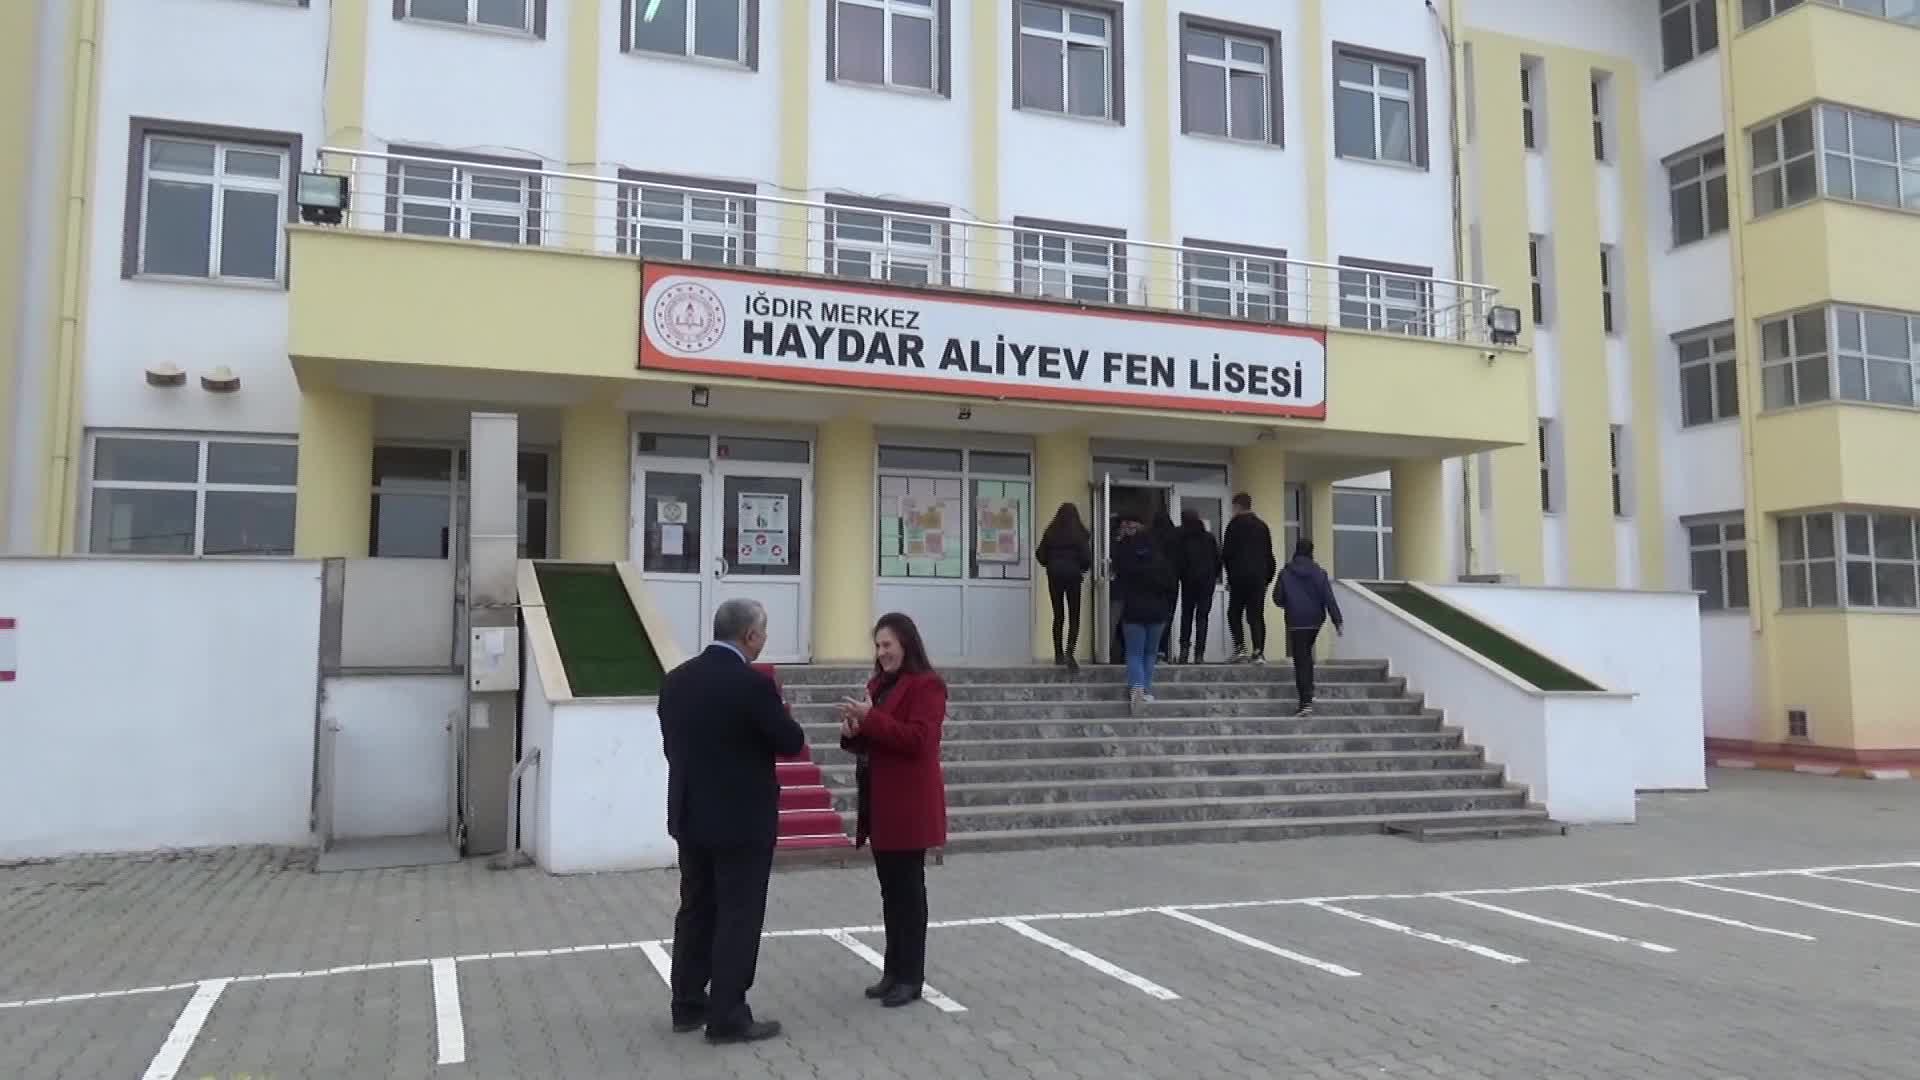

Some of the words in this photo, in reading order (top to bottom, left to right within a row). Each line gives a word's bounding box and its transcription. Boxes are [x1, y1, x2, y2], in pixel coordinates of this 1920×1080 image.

[745, 291, 812, 320] IĞDIR
[821, 302, 921, 330] MERKEZ
[743, 319, 925, 368] HAYDAR
[938, 334, 1089, 380] ALİYEV
[1103, 351, 1175, 388] FEN
[1189, 353, 1302, 399] LİSESİ
